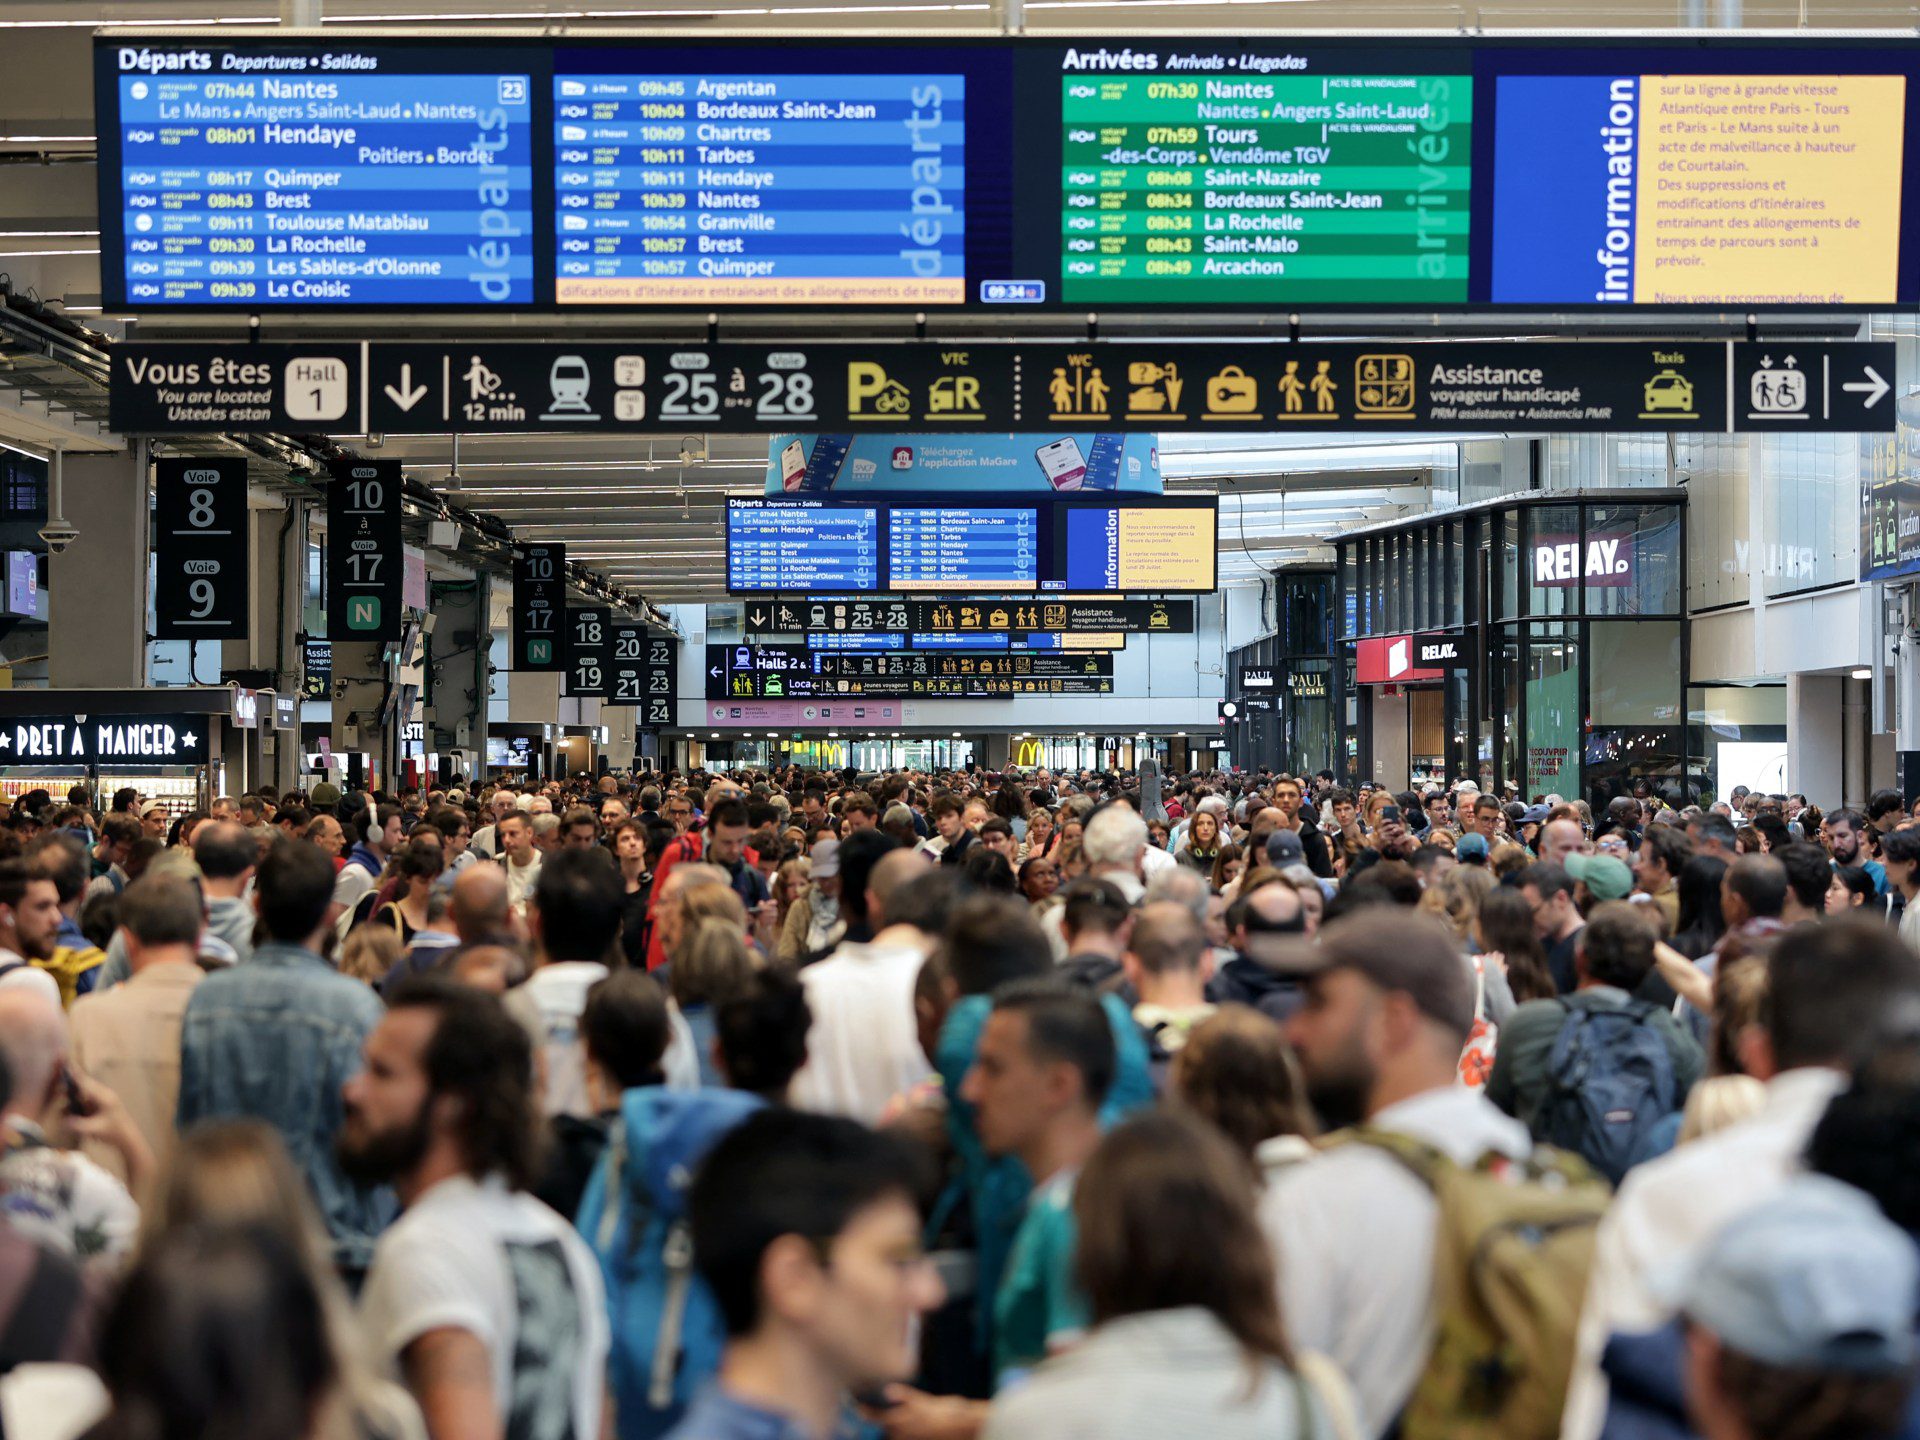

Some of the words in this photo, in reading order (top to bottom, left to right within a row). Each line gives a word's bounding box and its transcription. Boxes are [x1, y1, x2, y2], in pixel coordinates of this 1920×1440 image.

[118, 48, 212, 74] Départs
[221, 53, 307, 73] Departures
[321, 53, 377, 70] Salidas
[1063, 48, 1158, 70] Arrivées
[1165, 54, 1225, 70] Arrivals
[1239, 54, 1308, 73] Llegadas
[204, 82, 256, 98] 07h44
[263, 79, 338, 98] Nantes
[502, 82, 524, 98] 23
[696, 79, 776, 100] Argentan
[1147, 82, 1199, 98] 07h30
[1205, 79, 1274, 99] Nantes
[1660, 86, 1680, 96] sur
[1684, 83, 1695, 96] la
[1699, 83, 1730, 99] ligne
[1734, 83, 1742, 96] à
[1744, 83, 1789, 99] grande
[1793, 83, 1838, 96] vitesse
[159, 102, 180, 119] Le
[184, 102, 231, 119] Mans
[244, 102, 304, 122] Angers
[306, 102, 401, 119] Saint-Laud
[414, 102, 477, 119] Nantes
[697, 102, 778, 119] Bordeaux
[782, 102, 876, 119] Saint-Jean
[1197, 102, 1259, 119] Nantes
[1272, 102, 1332, 122] Angers
[1335, 102, 1429, 119] Saint-Laud
[1659, 103, 1728, 117] Atlantique
[1731, 104, 1766, 115] entre
[1769, 103, 1801, 115] Paris
[1814, 103, 1850, 115] Tours
[205, 127, 256, 144] 08h01
[263, 124, 356, 148] Hendaye
[697, 124, 772, 142] Chartres
[1147, 127, 1198, 144] 07h59
[1204, 124, 1259, 144] Tours
[358, 147, 424, 164] Poitiers
[697, 146, 755, 164] Tarbes
[1101, 147, 1197, 167] -des-Corps
[1209, 147, 1292, 164] Vendôme
[1294, 147, 1331, 164] TGV
[207, 171, 254, 186] 08h17
[264, 168, 341, 189] Quimper
[697, 168, 774, 190] Hendaye
[900, 84, 953, 277] départs
[1204, 168, 1321, 187] Saint-Nazaire
[1405, 79, 1450, 279] arrivées
[207, 193, 254, 208] 08h43
[265, 190, 312, 208] Brest
[1204, 190, 1286, 209] Bordeaux
[1289, 190, 1382, 209] Saint-Jean
[1596, 79, 1634, 302] information
[468, 107, 521, 301] départs
[698, 191, 760, 209] Nantes
[208, 216, 254, 231] 09h11
[264, 213, 344, 231] Toulouse
[348, 213, 429, 231] Matabiau
[697, 213, 775, 231] Granville
[1204, 213, 1224, 231] La
[1229, 213, 1304, 231] Rochelle
[209, 238, 255, 253] 09h30
[266, 235, 287, 253] La
[291, 235, 366, 253] Rochelle
[698, 235, 744, 253] Brest
[1203, 235, 1299, 253] Saint-Malo
[209, 260, 256, 275] 09h39
[267, 257, 297, 275] Les
[300, 257, 441, 275] Sables-d'Olonne
[698, 257, 775, 278] Quimper
[1203, 257, 1284, 275] Arcachon
[210, 282, 256, 298] 09h39
[267, 280, 289, 298] Le
[292, 280, 351, 298] Croisic
[941, 353, 969, 366] VTC
[1067, 354, 1093, 367] WC
[1652, 351, 1685, 365] Taxis
[125, 357, 201, 384] Vous
[208, 356, 272, 384] êtes
[296, 364, 337, 382] Hall
[1429, 364, 1543, 385] Assistance
[156, 389, 185, 404] You
[189, 392, 212, 404] are
[215, 389, 272, 404] located
[661, 373, 720, 415] 25
[728, 367, 745, 392] à
[756, 373, 815, 415] 28
[847, 362, 887, 413] P
[1430, 388, 1499, 405] voyageur
[1502, 387, 1581, 404] handicapé
[309, 388, 322, 412] 1
[167, 407, 227, 422] Ustedes
[228, 408, 271, 422] estan
[463, 404, 486, 422] 12
[489, 404, 525, 422] min
[919, 447, 974, 459] Téléchargez
[919, 456, 977, 469] l'application
[980, 456, 1018, 468] MaGare
[187, 472, 216, 482] Voie
[354, 468, 375, 477] Voie
[345, 481, 383, 509] 10
[730, 499, 763, 509] Départs
[188, 488, 216, 528] 8
[360, 517, 368, 529] à
[781, 527, 814, 535] Hendaye
[354, 541, 375, 550] Voie
[854, 520, 873, 589] départs
[1105, 509, 1117, 589] information
[187, 562, 216, 573] Voie
[345, 554, 383, 581] 17
[526, 558, 553, 578] 10
[189, 579, 216, 618] 9
[355, 603, 372, 623] N
[526, 609, 553, 629] 17
[851, 612, 872, 627] 25
[886, 612, 908, 627] 28
[1071, 608, 1113, 617] Assistance
[575, 622, 602, 642] 18
[533, 644, 546, 658] N
[615, 638, 640, 657] 20
[649, 648, 669, 662] 22
[756, 658, 787, 669] Halls
[790, 658, 798, 669] 2
[575, 667, 602, 687] 19
[649, 676, 669, 691] 23
[1245, 671, 1273, 679] PAUL
[1291, 674, 1325, 687] PAUL
[616, 679, 640, 697] 21
[882, 682, 909, 690] voyageurs
[649, 706, 670, 720] 24
[17, 724, 66, 756] PRET
[71, 725, 85, 756] A
[98, 724, 176, 755] MANGER
